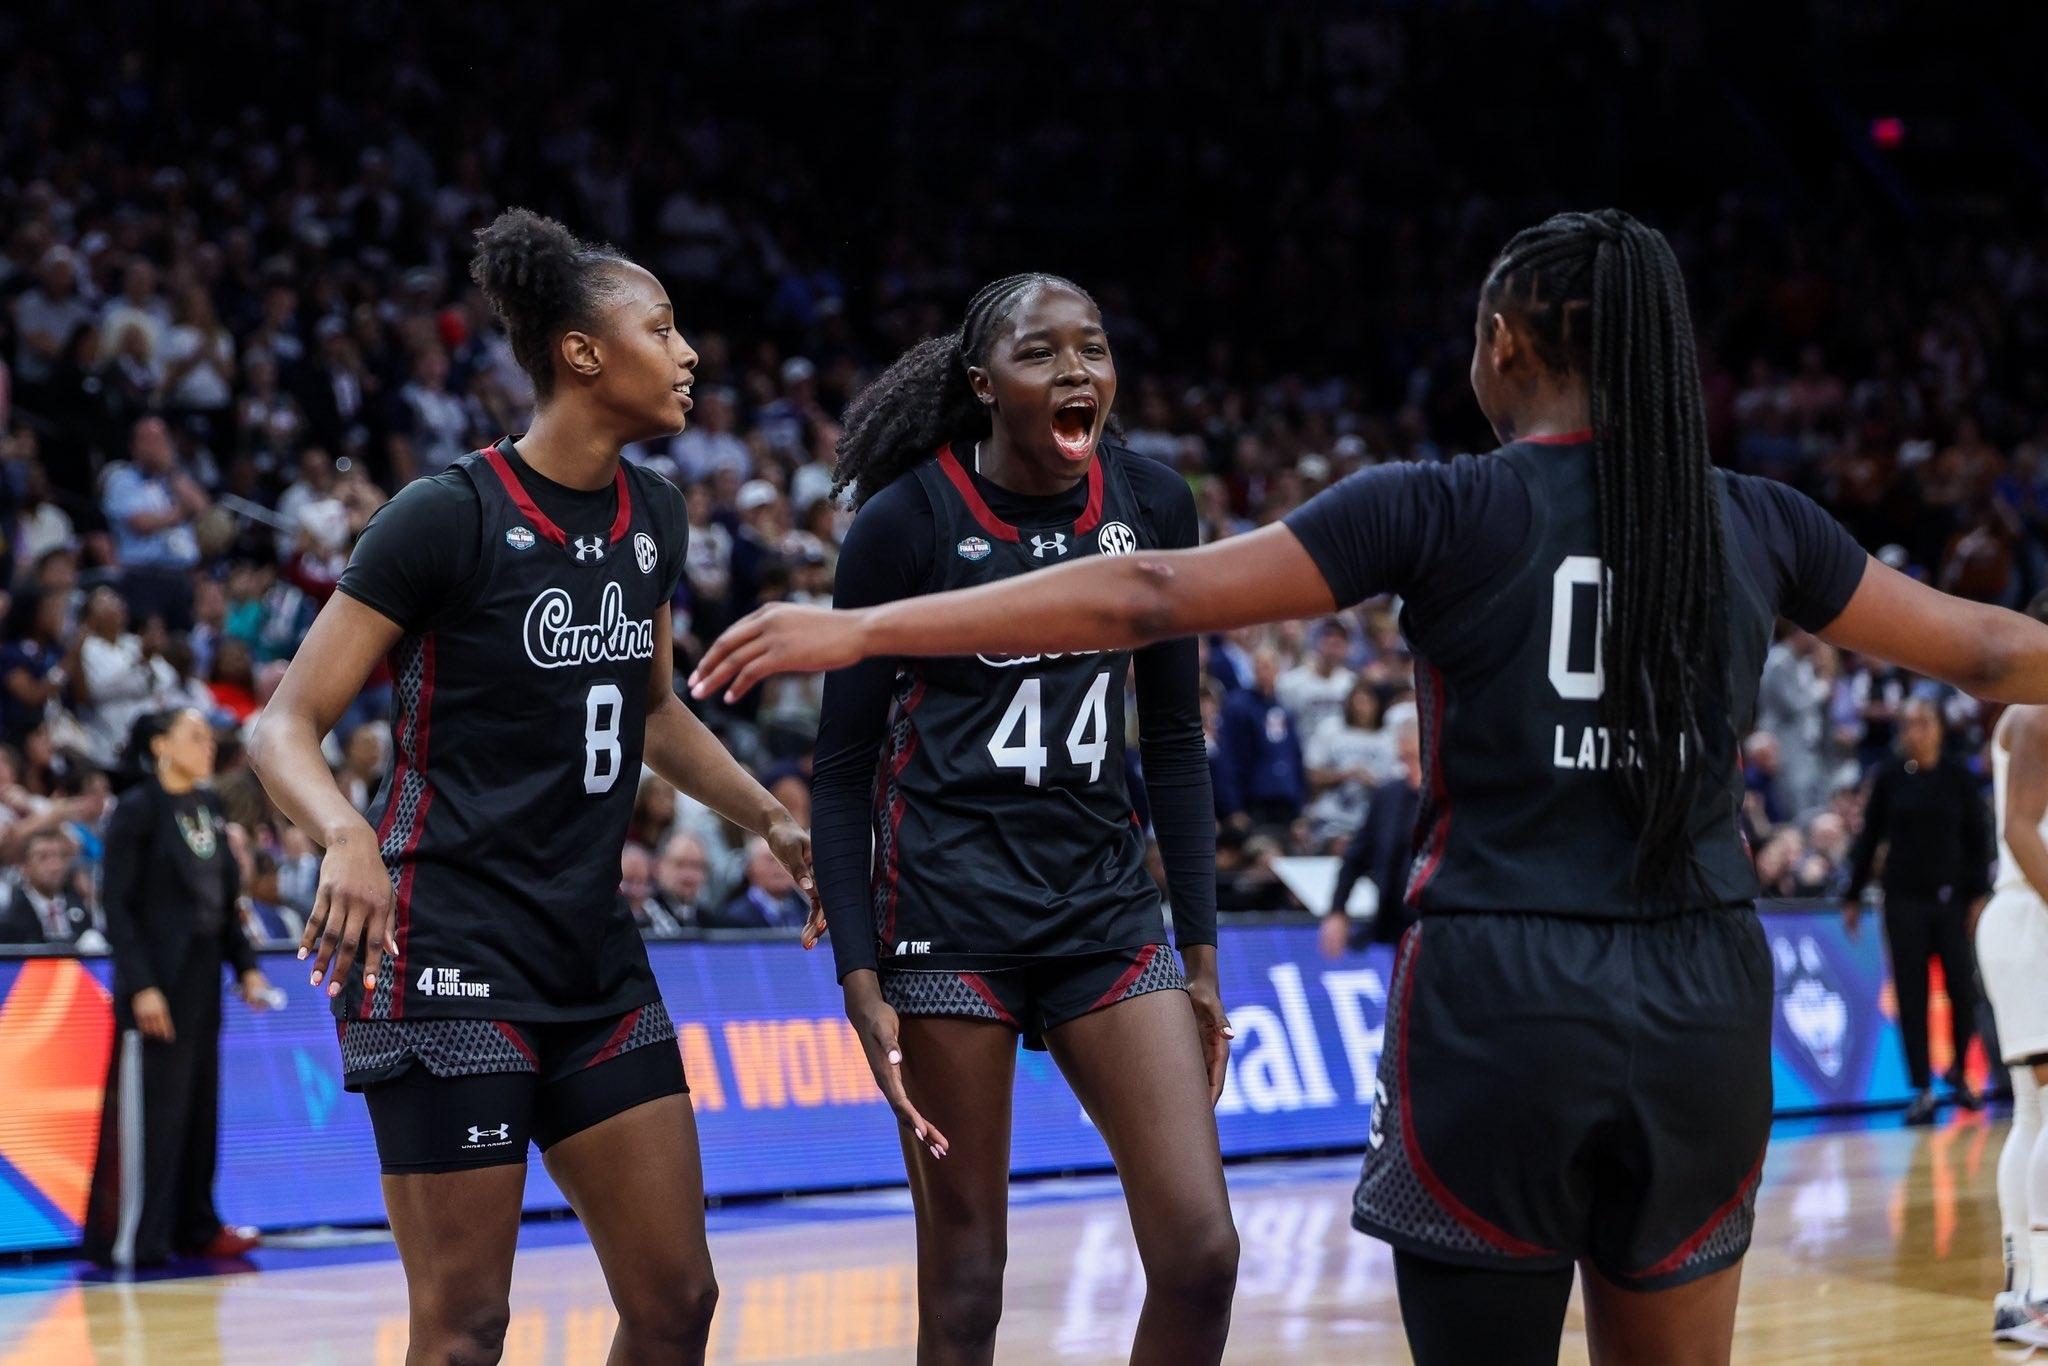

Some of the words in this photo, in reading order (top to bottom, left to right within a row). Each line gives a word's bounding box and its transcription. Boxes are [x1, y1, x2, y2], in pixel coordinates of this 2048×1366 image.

[636, 535, 655, 571] SEC
[1100, 525, 1133, 557] SEC
[523, 581, 654, 668] Carolina
[1548, 555, 1613, 700] 0
[583, 684, 624, 794] 8
[987, 672, 1110, 787] 44
[911, 941, 931, 954] THE
[416, 967, 434, 996] 4
[438, 968, 460, 982] THE
[437, 982, 490, 998] CULTURE
